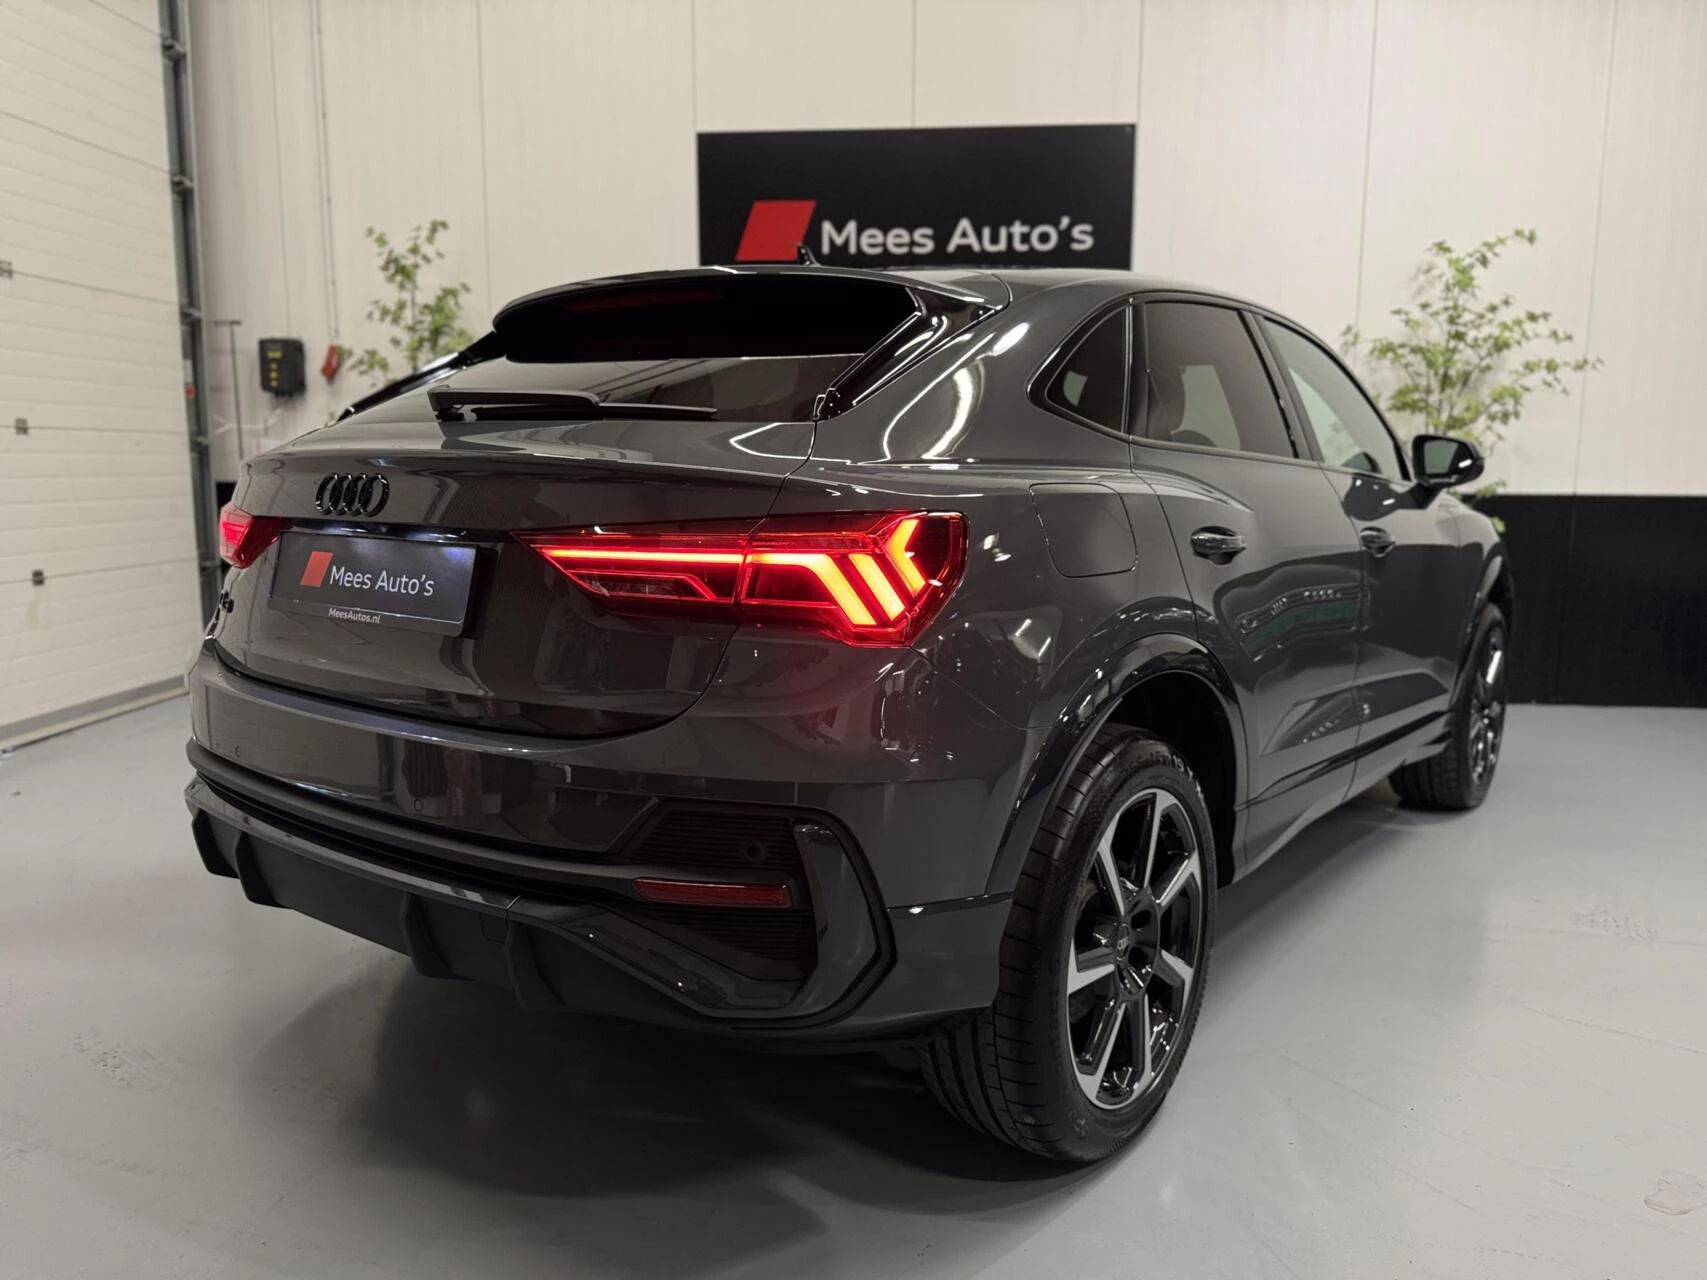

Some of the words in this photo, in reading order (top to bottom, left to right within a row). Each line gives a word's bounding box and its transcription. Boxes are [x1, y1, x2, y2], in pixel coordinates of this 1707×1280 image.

[821, 220, 935, 255] Mees
[946, 216, 1094, 253] Auto's
[329, 565, 372, 589] Mees
[374, 570, 435, 596] Auto's
[328, 607, 382, 624] MeesAutos.nl
